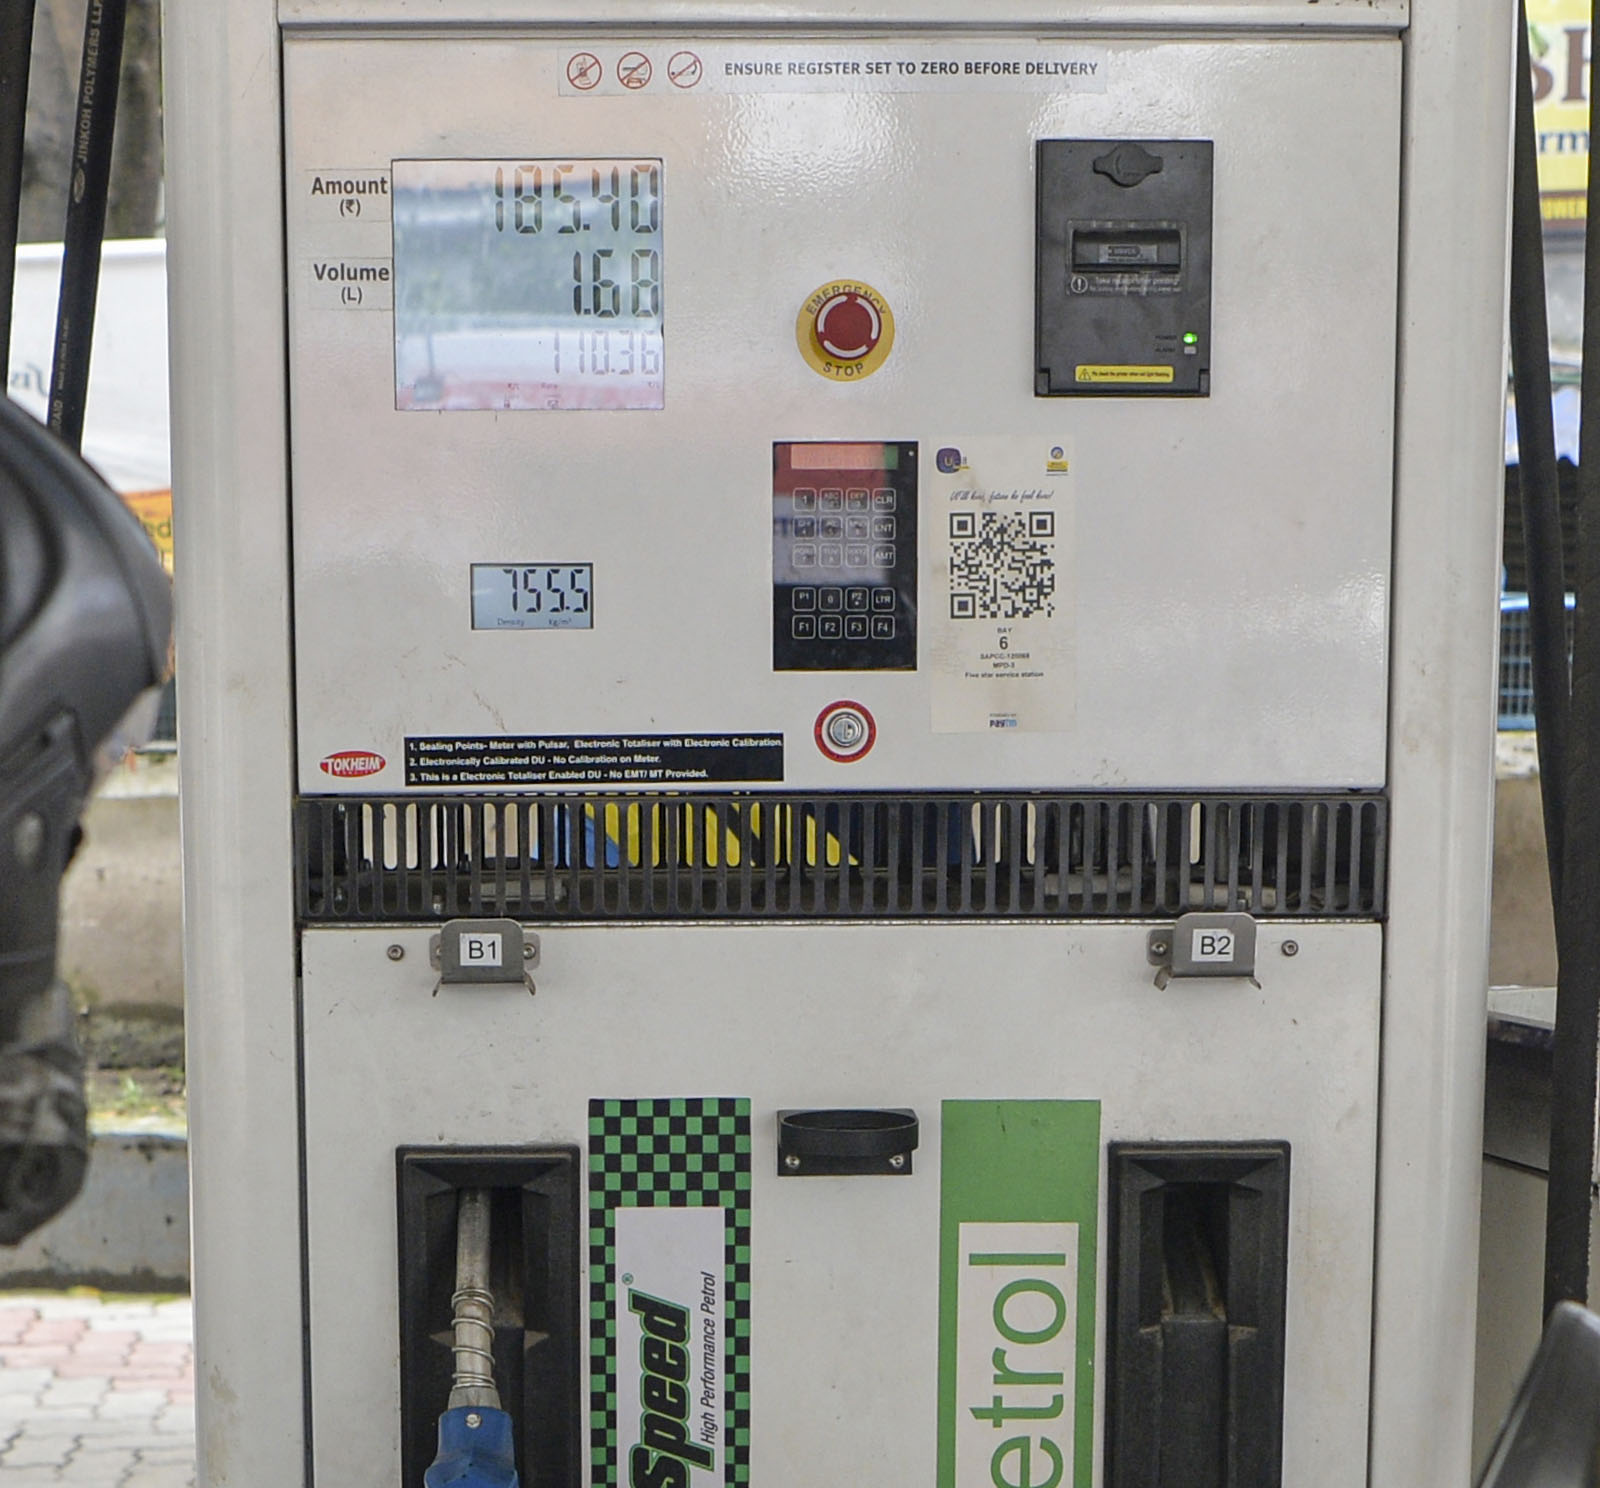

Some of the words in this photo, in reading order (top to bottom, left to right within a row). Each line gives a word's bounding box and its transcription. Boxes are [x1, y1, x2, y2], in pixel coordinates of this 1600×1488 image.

[725, 62, 783, 76] ENSURE
[787, 62, 861, 75] REGISTER
[865, 62, 891, 75] SET
[896, 62, 916, 75] TO
[920, 62, 959, 75] ZERO
[964, 62, 1020, 75] BEFORE
[1025, 62, 1099, 75] DELIVERY
[311, 176, 388, 196] Amount
[495, 165, 659, 233] 185.40
[314, 263, 390, 282] Volume
[573, 249, 660, 318] 1.68
[341, 286, 363, 304] (L)
[805, 284, 888, 316] EMERGENCY
[554, 329, 660, 376] 110.36
[822, 361, 864, 377] STOP
[503, 568, 588, 613] 755.5
[799, 622, 810, 632] F1
[824, 622, 837, 632] F2
[850, 622, 863, 632] F3
[876, 622, 889, 632] F4
[999, 636, 1008, 650] 6
[409, 742, 417, 751] 1.
[419, 741, 453, 752] Sealing
[489, 741, 515, 750] Meter
[517, 740, 536, 749] with
[574, 739, 620, 748] Electronic
[622, 739, 661, 748] Totaliser
[663, 738, 682, 747] with
[684, 738, 730, 748] Electronic
[324, 757, 381, 775] TOKHEIM
[409, 757, 417, 766] 2.
[419, 757, 481, 768] Electronically
[482, 755, 530, 765] Calibrated
[531, 756, 545, 765] DU
[552, 755, 566, 764] No
[568, 754, 618, 764] Calibration
[409, 773, 418, 782] 3.
[420, 772, 440, 781] This
[441, 772, 449, 781] is
[460, 771, 506, 781] Electronic
[508, 771, 547, 780] Totaliser
[549, 770, 586, 779] Enabled
[587, 770, 601, 779] DU
[609, 769, 623, 779] No
[665, 768, 709, 778] Provided.
[467, 938, 498, 962] B1
[1199, 934, 1231, 957] B2
[699, 1271, 716, 1315] Petrol
[699, 1319, 716, 1413] Performance
[699, 1416, 716, 1446] High
